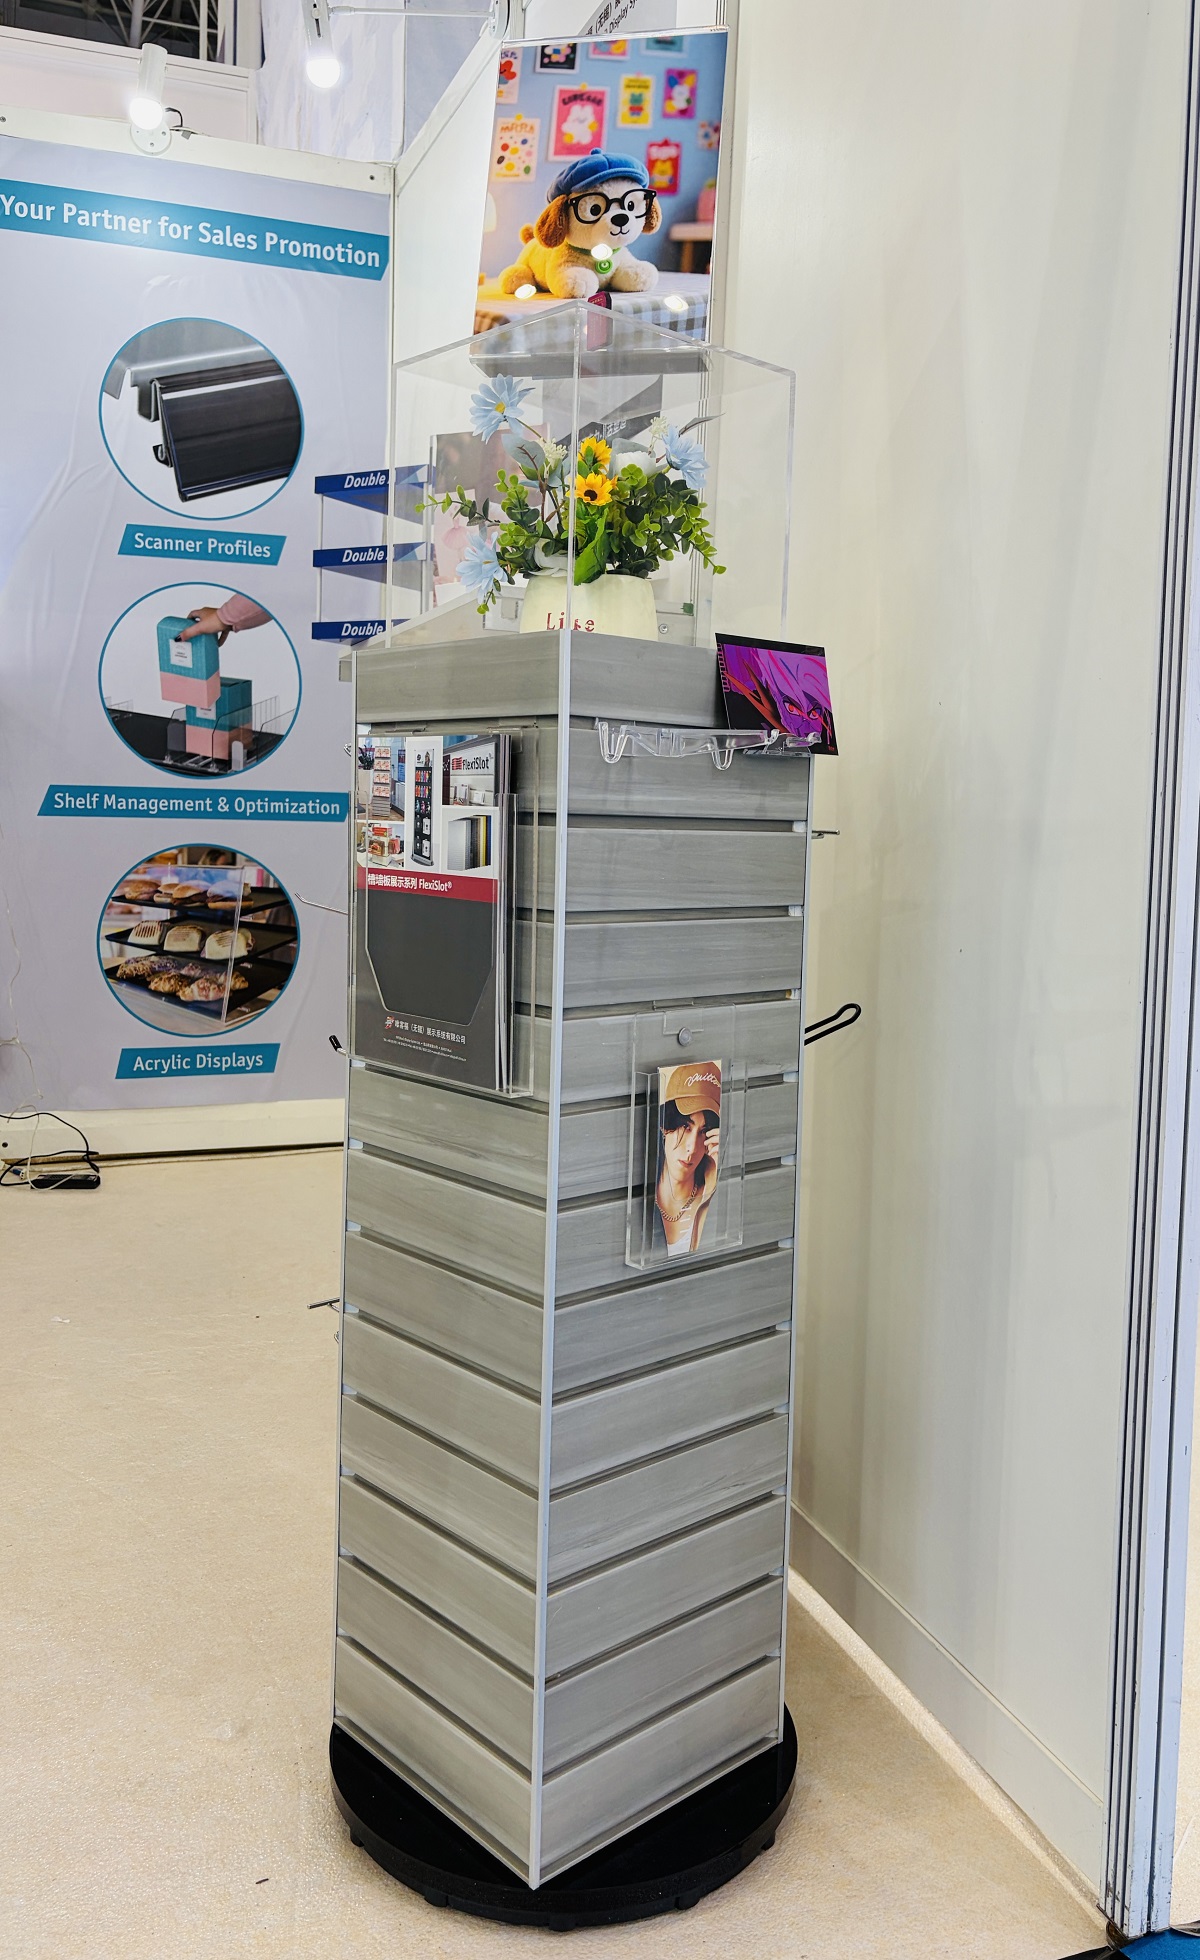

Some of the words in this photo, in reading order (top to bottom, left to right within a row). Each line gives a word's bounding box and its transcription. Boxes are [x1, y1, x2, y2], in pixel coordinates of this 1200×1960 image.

[609, 4, 628, 33] Display
[0, 194, 55, 221] Your
[63, 202, 152, 235] Partner
[158, 215, 193, 240] for
[198, 222, 258, 251] Sales
[264, 231, 380, 268] Promotion
[344, 472, 386, 489] Double
[134, 532, 203, 552] Scanner
[207, 538, 271, 558] Profiles
[342, 547, 385, 563] Double
[341, 621, 384, 637] Double
[54, 792, 100, 809] Shelf
[103, 793, 213, 814] Management
[217, 797, 230, 812] &
[234, 796, 341, 816] Optimization
[133, 1054, 191, 1074] Acrylic
[195, 1052, 264, 1071] Displays
